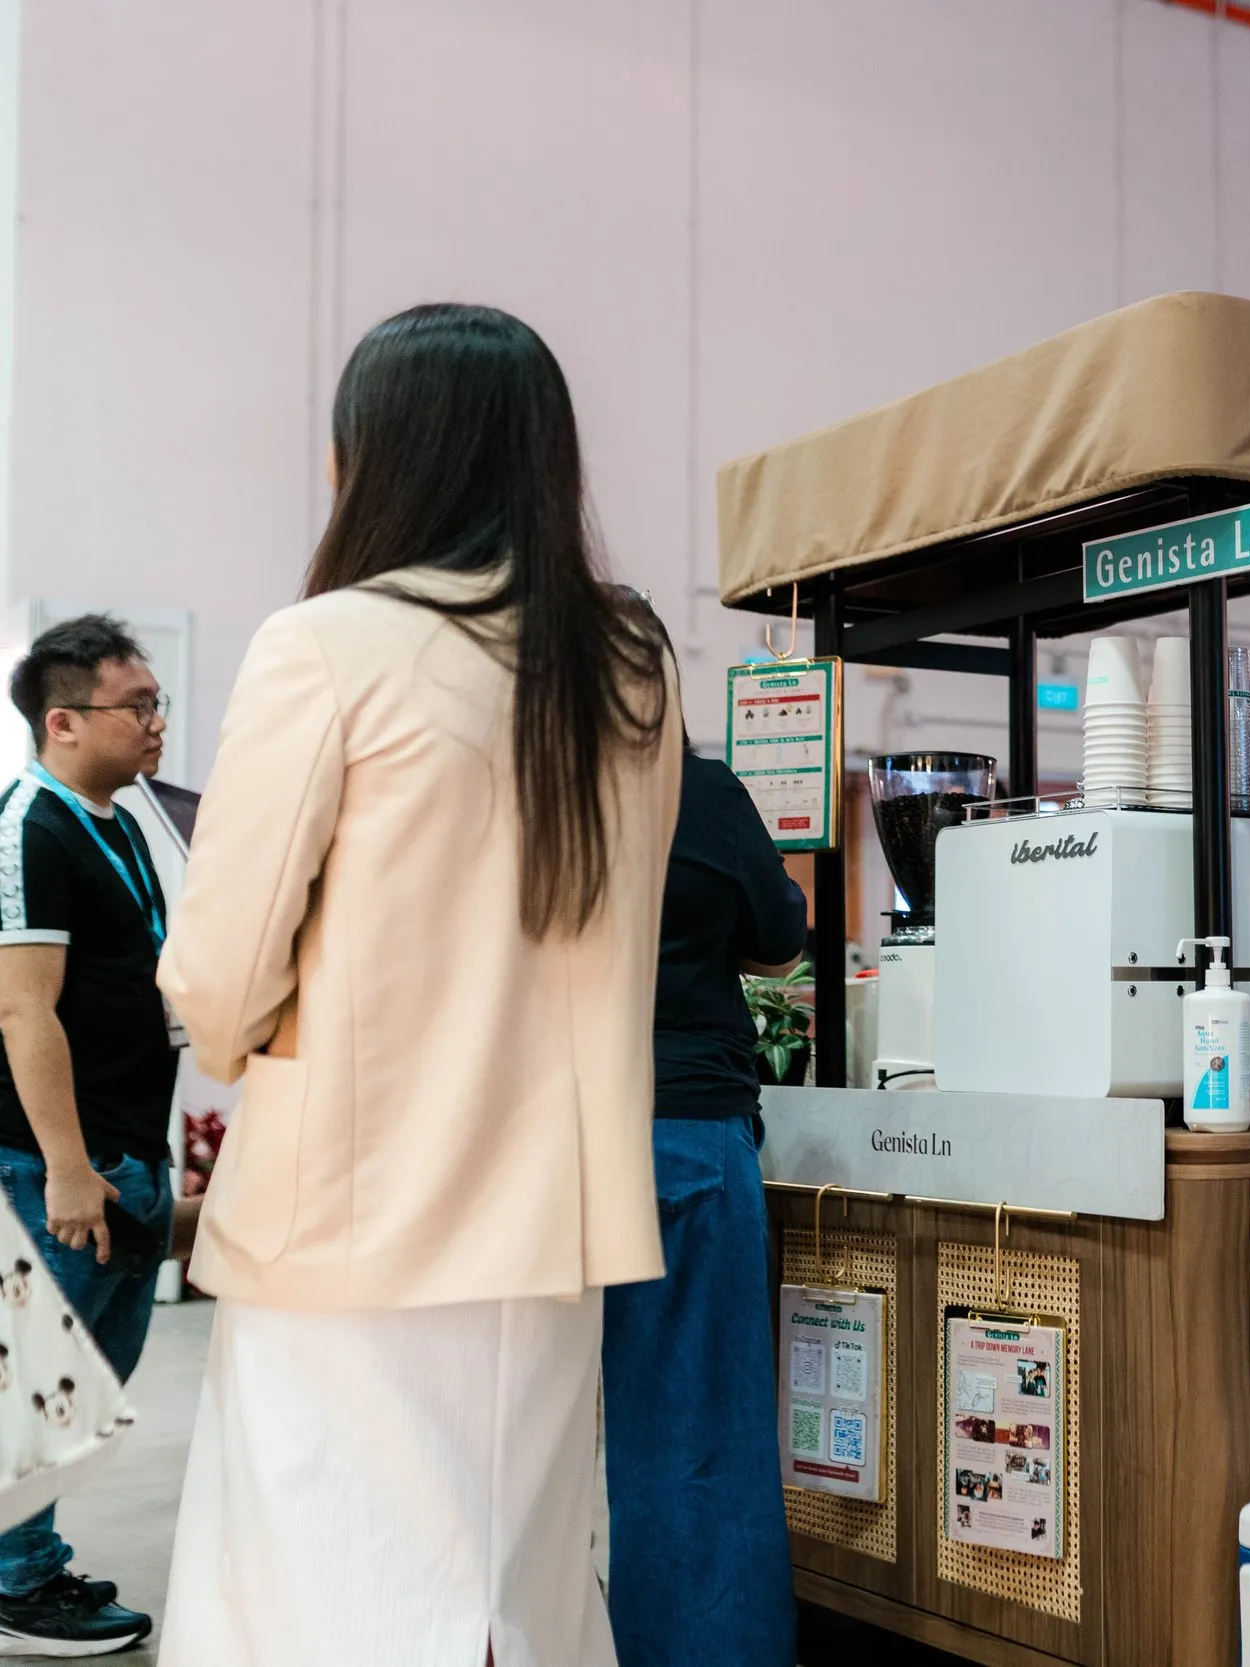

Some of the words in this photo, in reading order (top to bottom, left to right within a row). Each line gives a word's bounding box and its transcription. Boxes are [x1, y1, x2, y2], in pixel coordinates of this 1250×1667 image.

[1096, 533, 1215, 588] Genista
[1010, 831, 1099, 865] iberital
[871, 1128, 928, 1155] Genista
[931, 1132, 952, 1156] Ln
[791, 1312, 829, 1328] Connect
[830, 1317, 851, 1330] with
[852, 1319, 866, 1333] Us
[970, 1341, 974, 1350] A
[974, 1341, 986, 1350] TRIP
[986, 1342, 1000, 1352] DOWN
[1000, 1343, 1021, 1355] MEMORY
[1022, 1346, 1036, 1355] LANE
